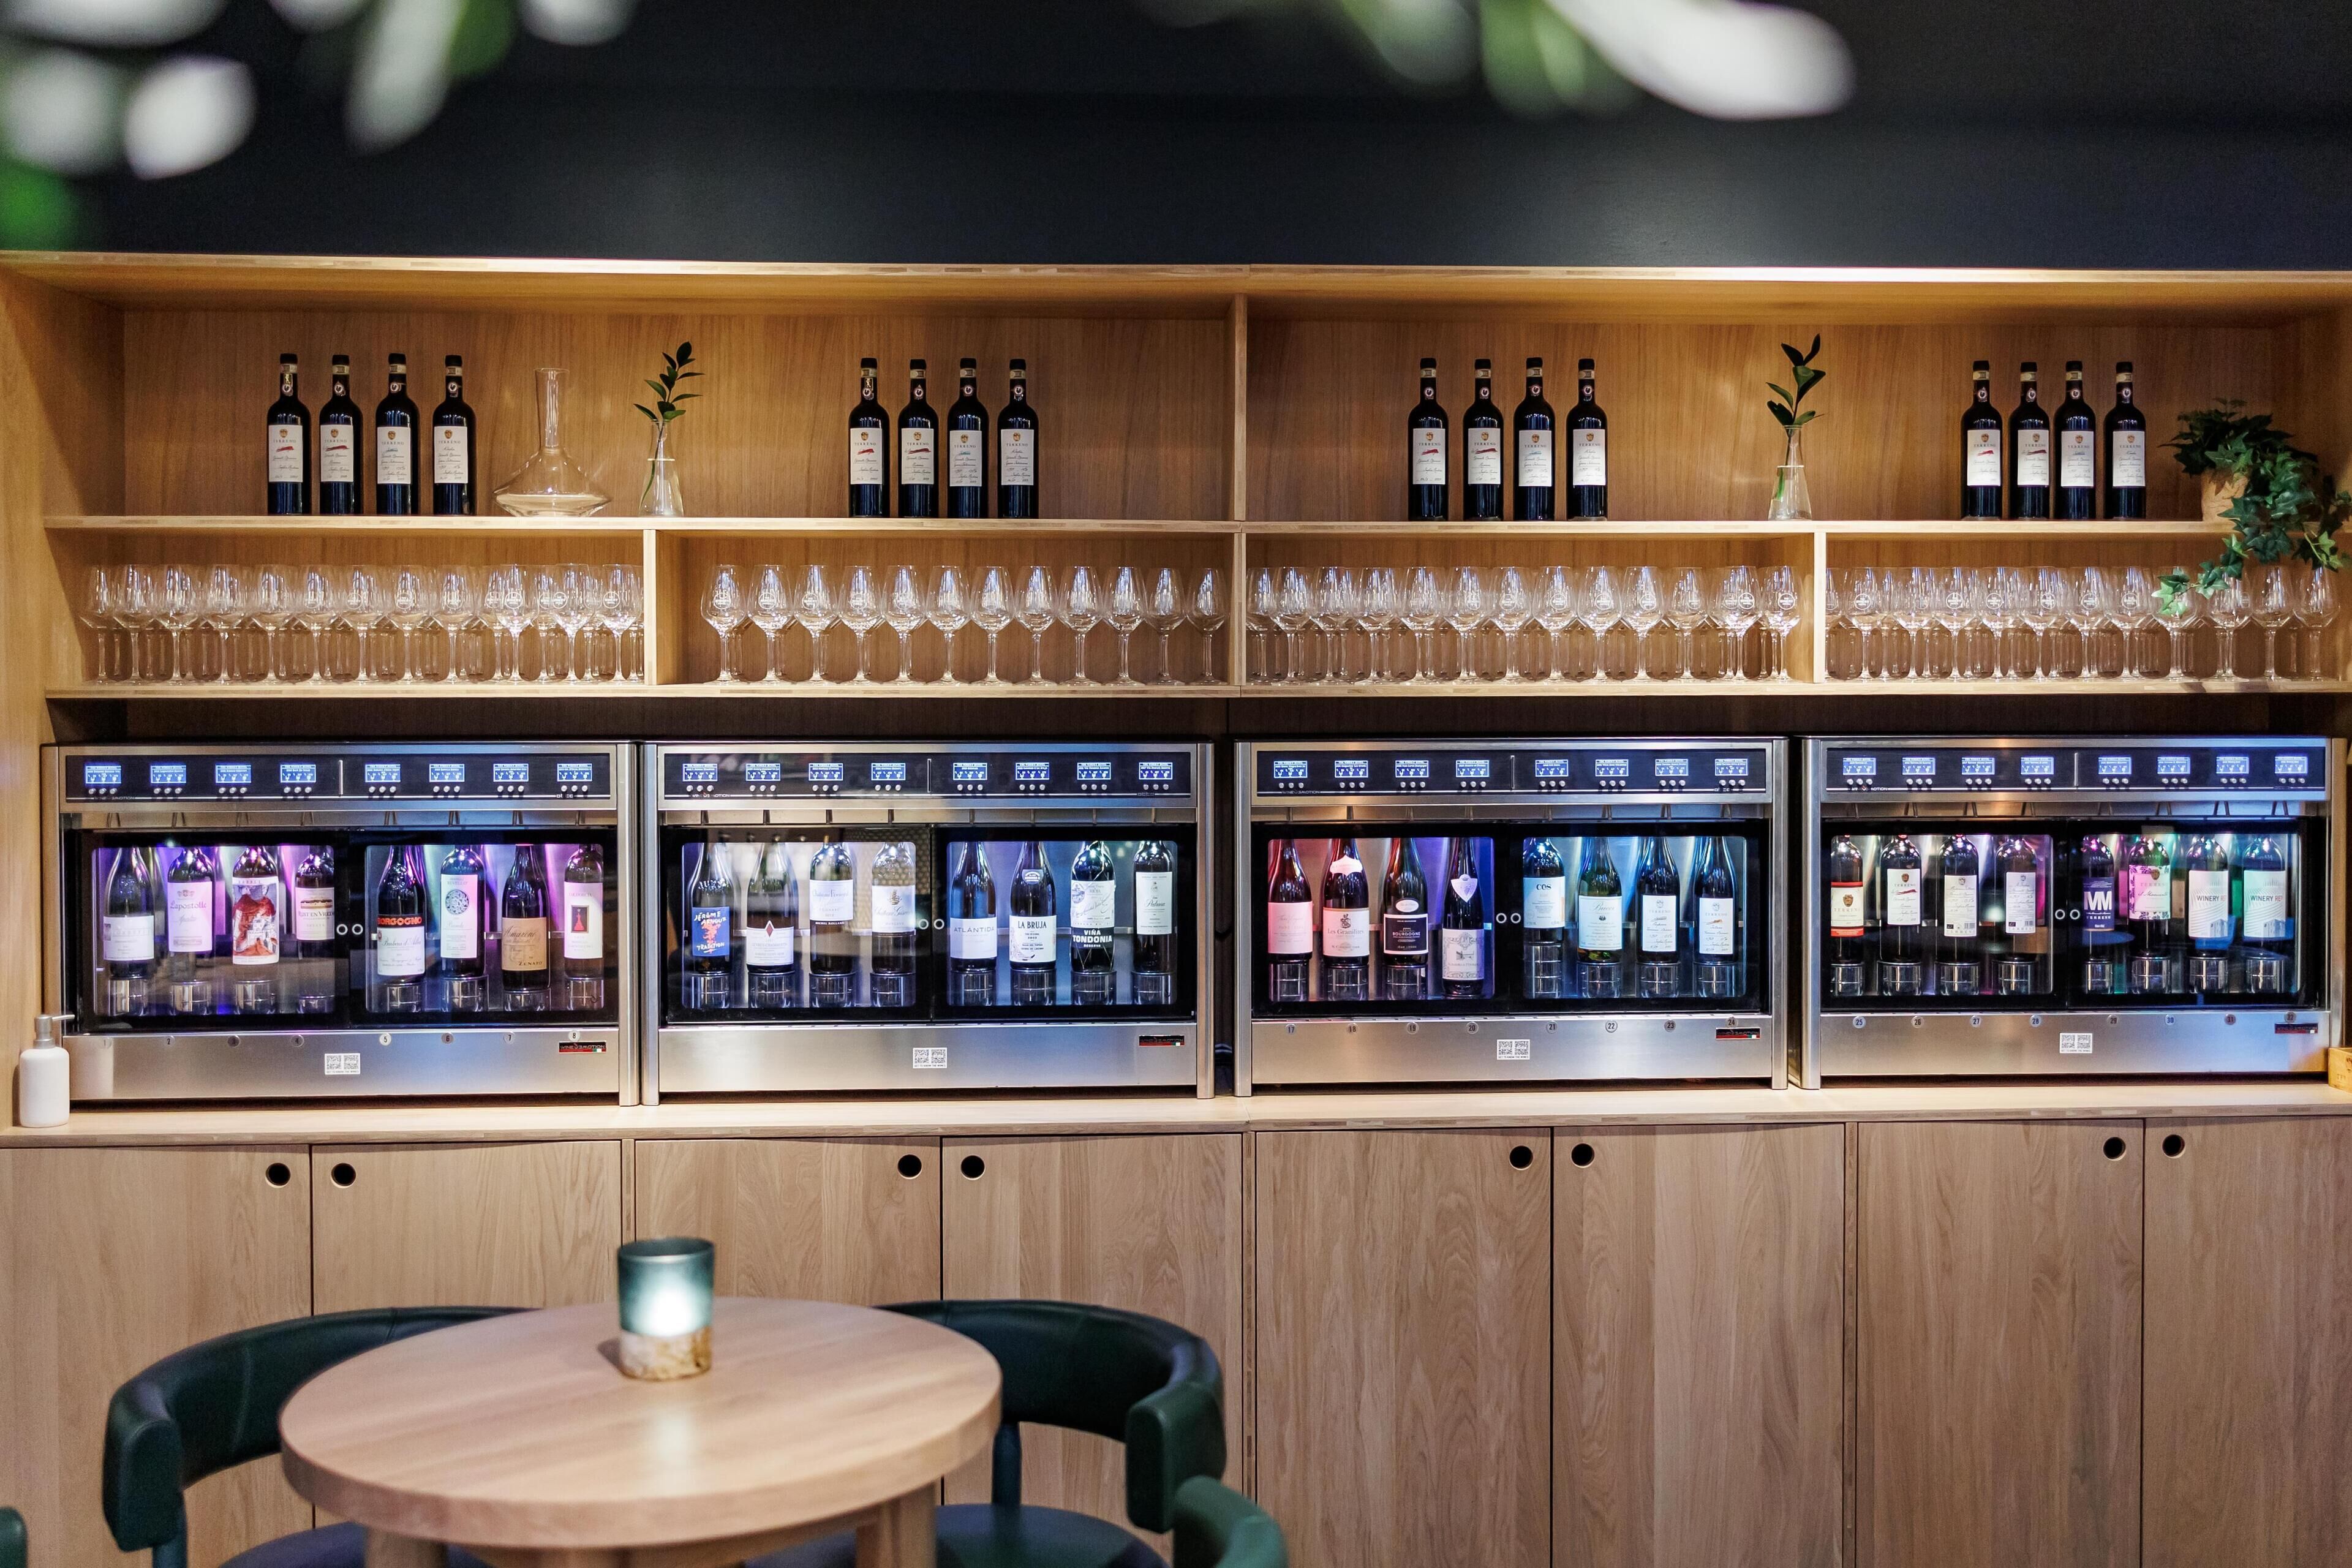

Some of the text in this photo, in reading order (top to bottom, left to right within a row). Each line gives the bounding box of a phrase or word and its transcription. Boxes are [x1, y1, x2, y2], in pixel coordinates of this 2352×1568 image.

[170, 900, 206, 911] Lapostolle
[377, 916, 422, 926] BORGOGNO
[1017, 920, 1025, 929] LA
[696, 942, 725, 951] TRADITION
